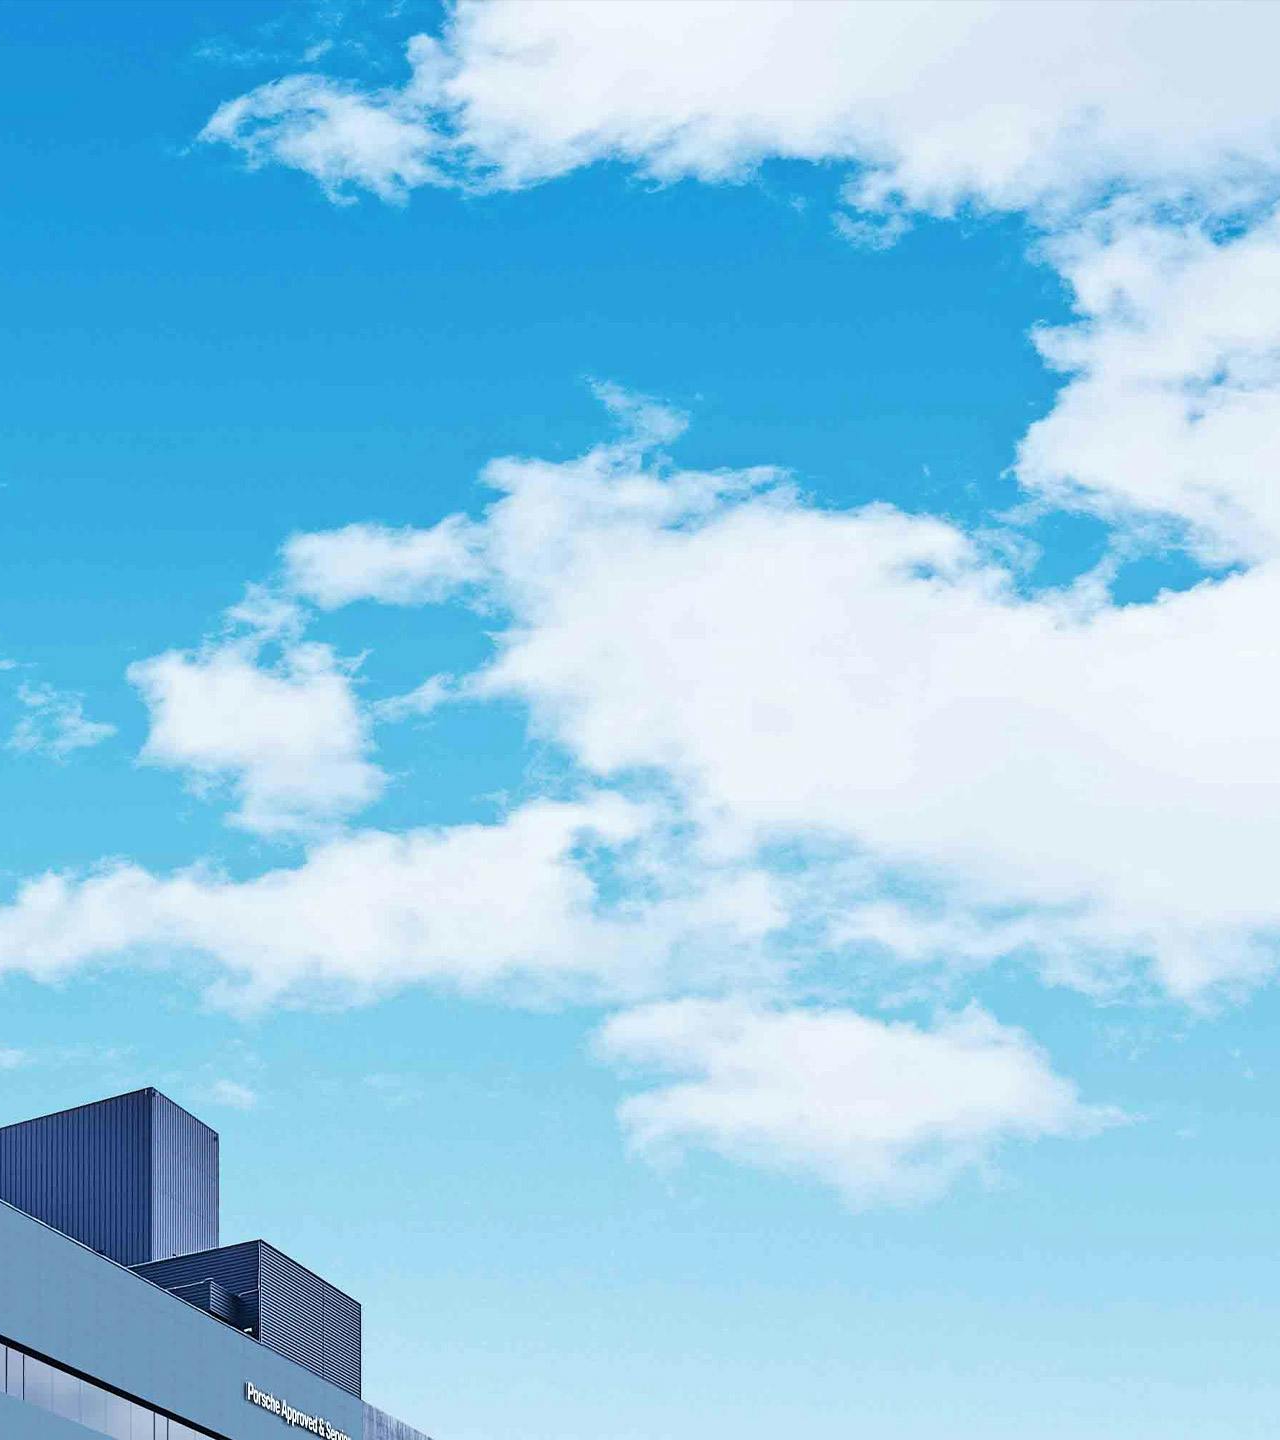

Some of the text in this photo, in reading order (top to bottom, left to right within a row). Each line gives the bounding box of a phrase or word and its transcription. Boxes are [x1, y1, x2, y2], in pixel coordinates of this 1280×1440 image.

[247, 1382, 281, 1414] Porsche
[281, 1400, 318, 1433] Approved
[318, 1418, 325, 1437] &
